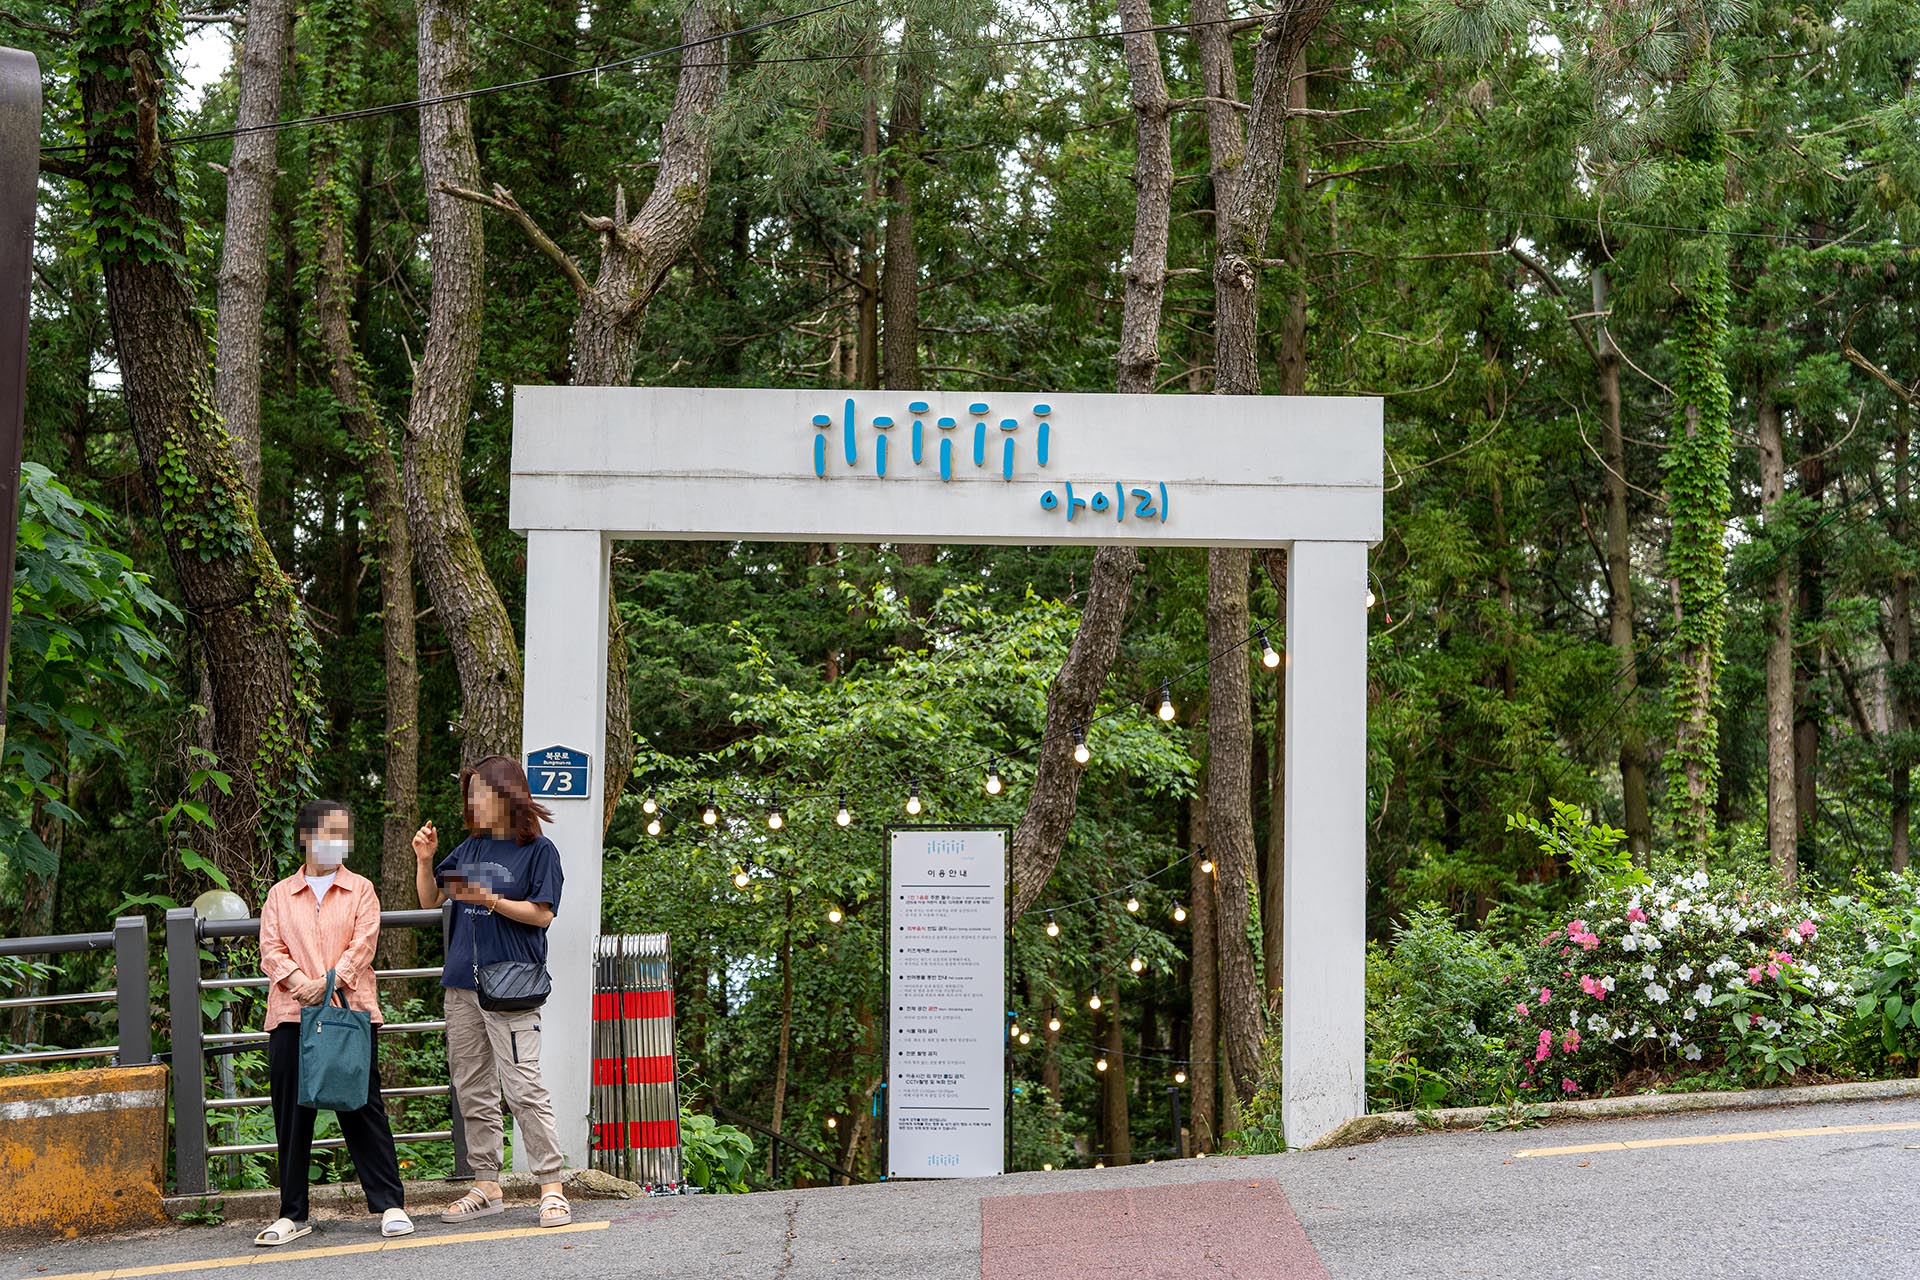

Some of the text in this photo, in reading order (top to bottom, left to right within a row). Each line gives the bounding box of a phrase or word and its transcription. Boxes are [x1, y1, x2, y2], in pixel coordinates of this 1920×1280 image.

[1040, 480, 1169, 523] 아이리
[545, 752, 570, 761] 북문로
[541, 771, 573, 792] 73
